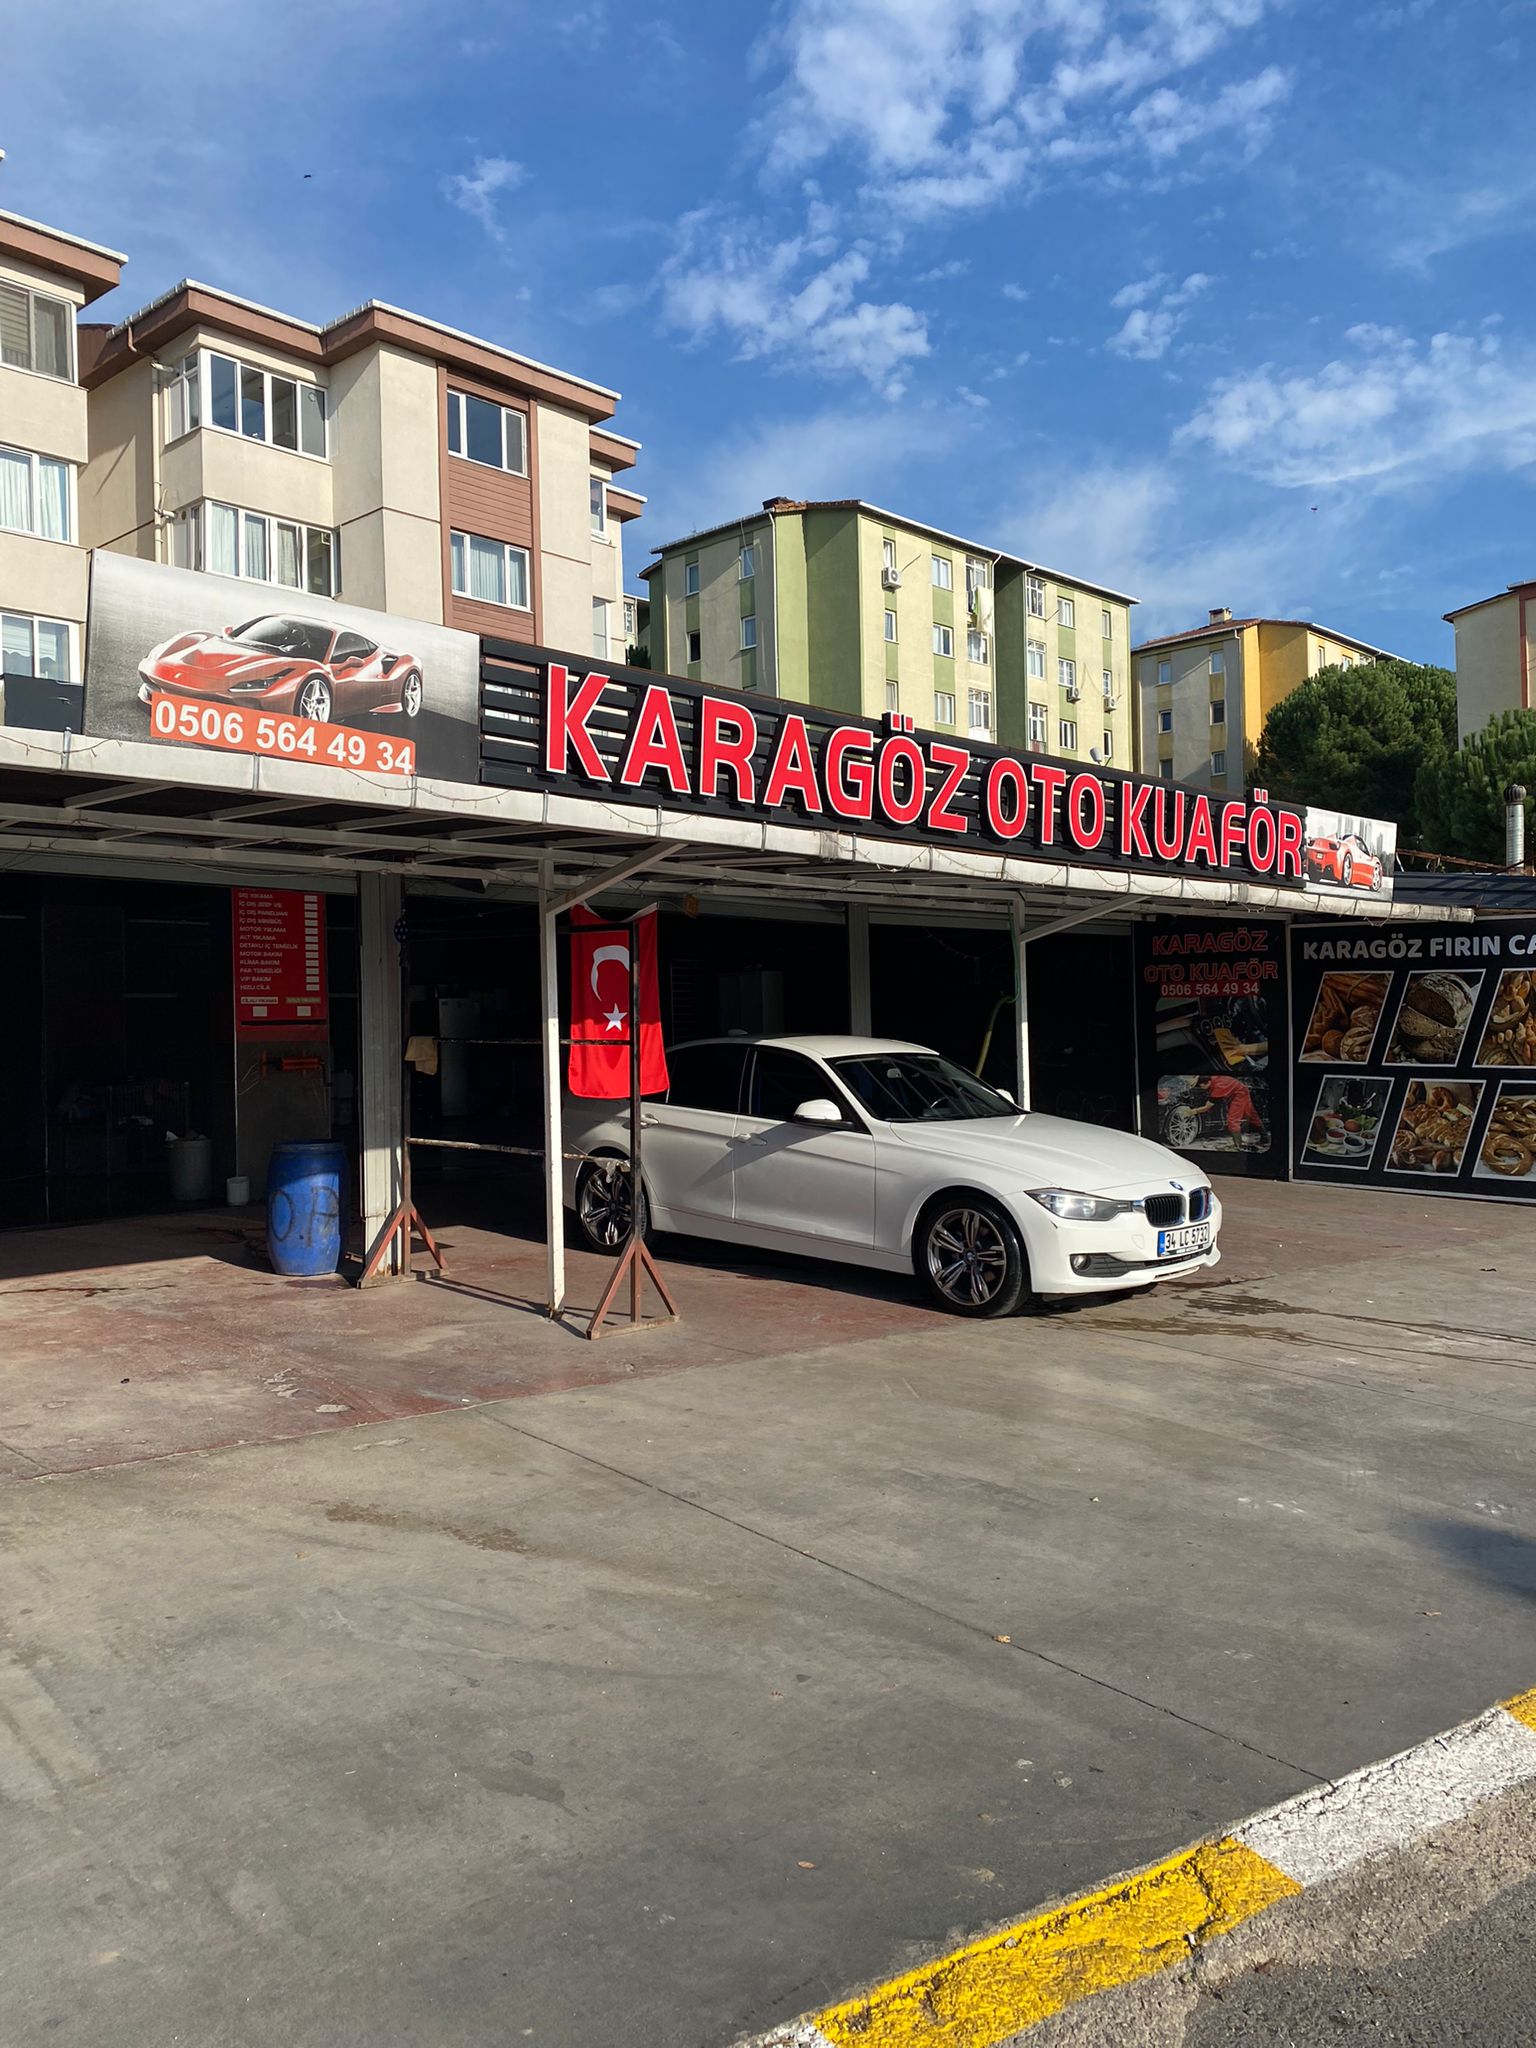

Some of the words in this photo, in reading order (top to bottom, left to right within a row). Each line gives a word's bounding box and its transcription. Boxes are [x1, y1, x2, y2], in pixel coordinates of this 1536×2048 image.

[154, 700, 244, 744] 0506
[255, 718, 317, 756] 564
[327, 732, 366, 766] 49
[376, 741, 413, 775] 34
[546, 661, 971, 834] KARAGÖZ
[986, 756, 1106, 851] OTO
[1120, 787, 1303, 878] KUAFÖR
[1152, 927, 1269, 956] KARAGÖZ
[1303, 933, 1423, 960] KARAGÖZ
[1430, 935, 1500, 957] FIRIN
[1143, 964, 1185, 983] OTO
[1189, 957, 1278, 982] KUAFÖR
[1160, 984, 1192, 996] 0506
[1195, 983, 1219, 996] 564
[1223, 982, 1239, 995] 49
[1242, 981, 1260, 994] 34
[1165, 1233, 1176, 1249] 34
[1179, 1230, 1189, 1246] LC
